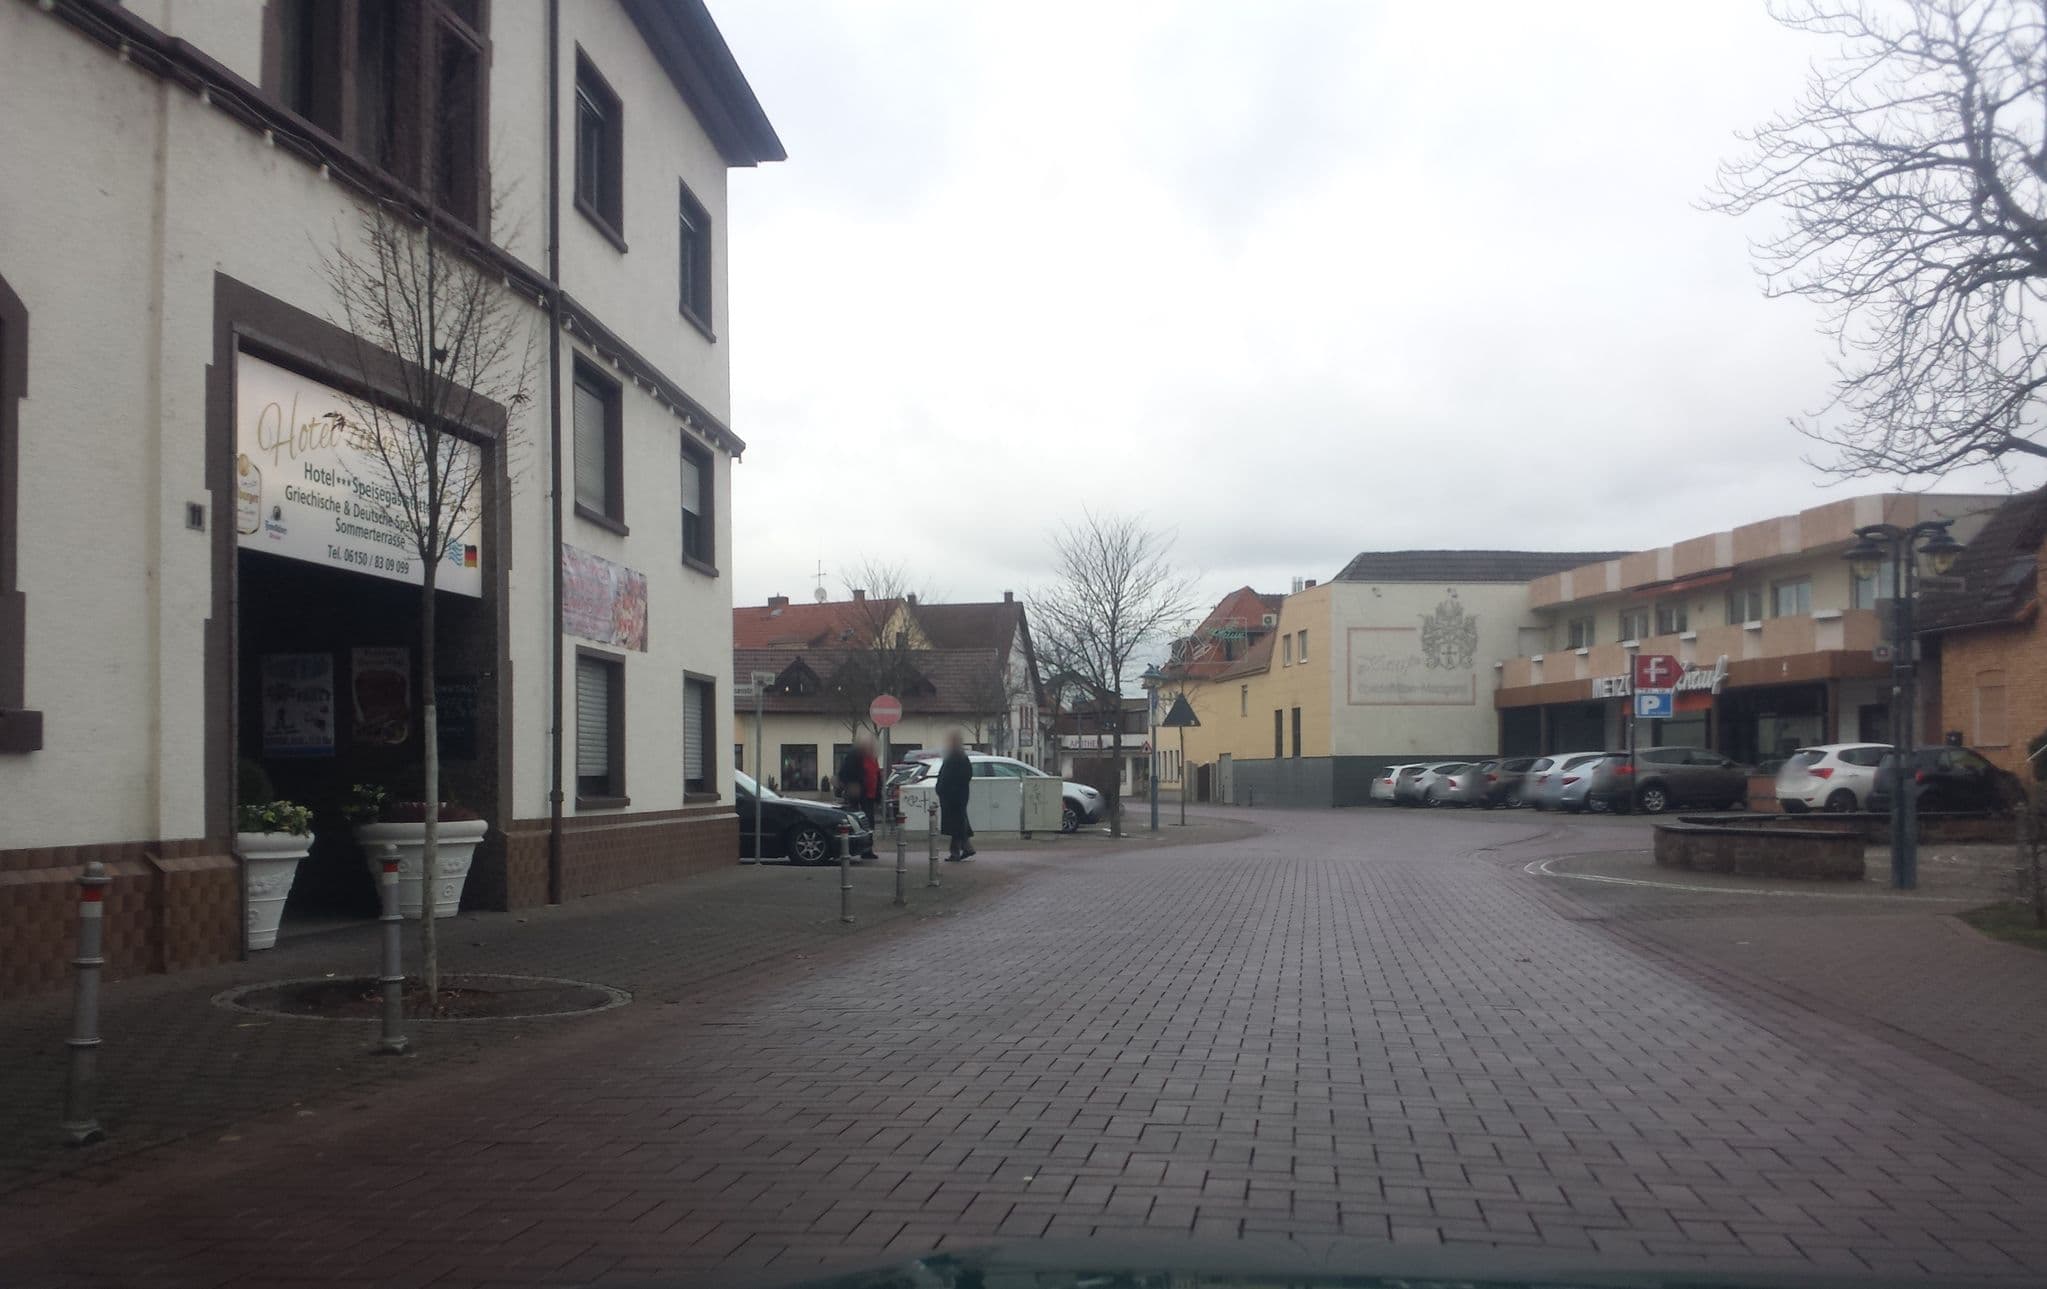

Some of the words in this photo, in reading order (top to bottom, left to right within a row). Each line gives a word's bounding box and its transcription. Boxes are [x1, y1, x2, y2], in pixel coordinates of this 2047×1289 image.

[257, 391, 338, 467] Hotel
[304, 461, 335, 488] Hotel
[285, 485, 341, 513] Griechische
[343, 500, 351, 516] &
[335, 517, 405, 548] Sommerterrasse
[327, 544, 342, 560] Tel.
[344, 548, 368, 567] 06150
[374, 555, 384, 569] 83
[385, 558, 395, 571] 09
[396, 560, 410, 574] 099
[1640, 695, 1660, 715] P
